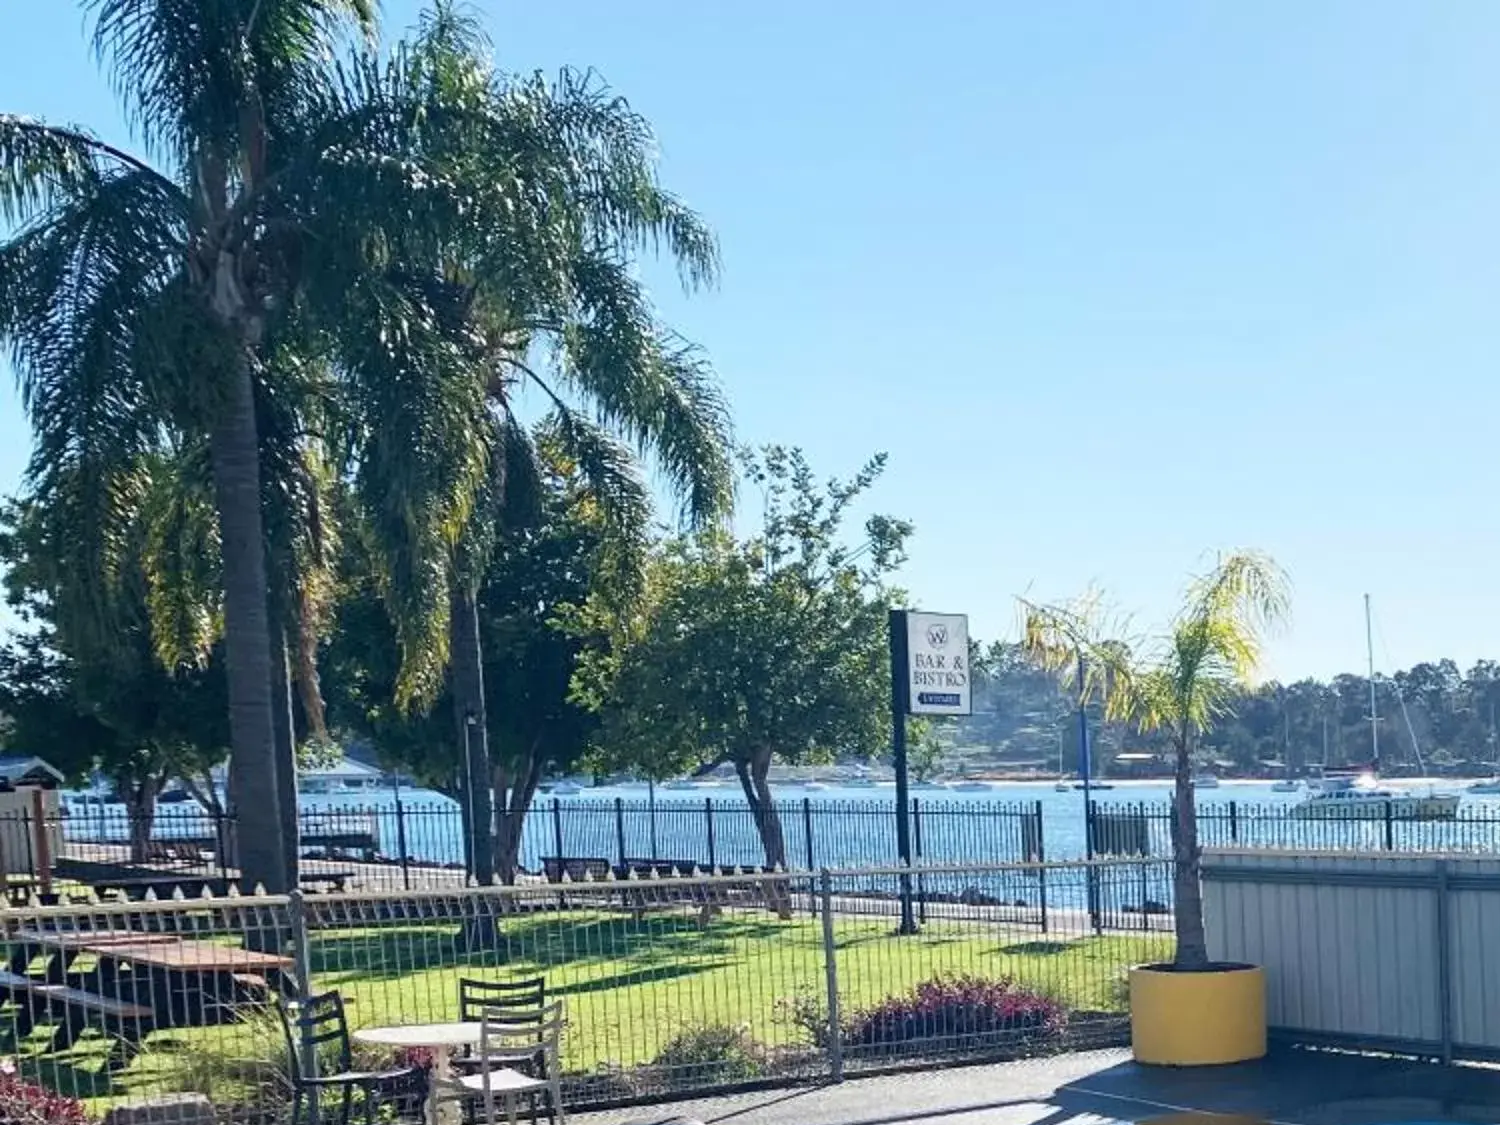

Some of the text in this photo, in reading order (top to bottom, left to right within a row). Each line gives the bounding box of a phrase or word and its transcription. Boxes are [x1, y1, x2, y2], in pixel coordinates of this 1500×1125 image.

[916, 654, 963, 669] BAR &
[913, 671, 967, 686] BISTRO
